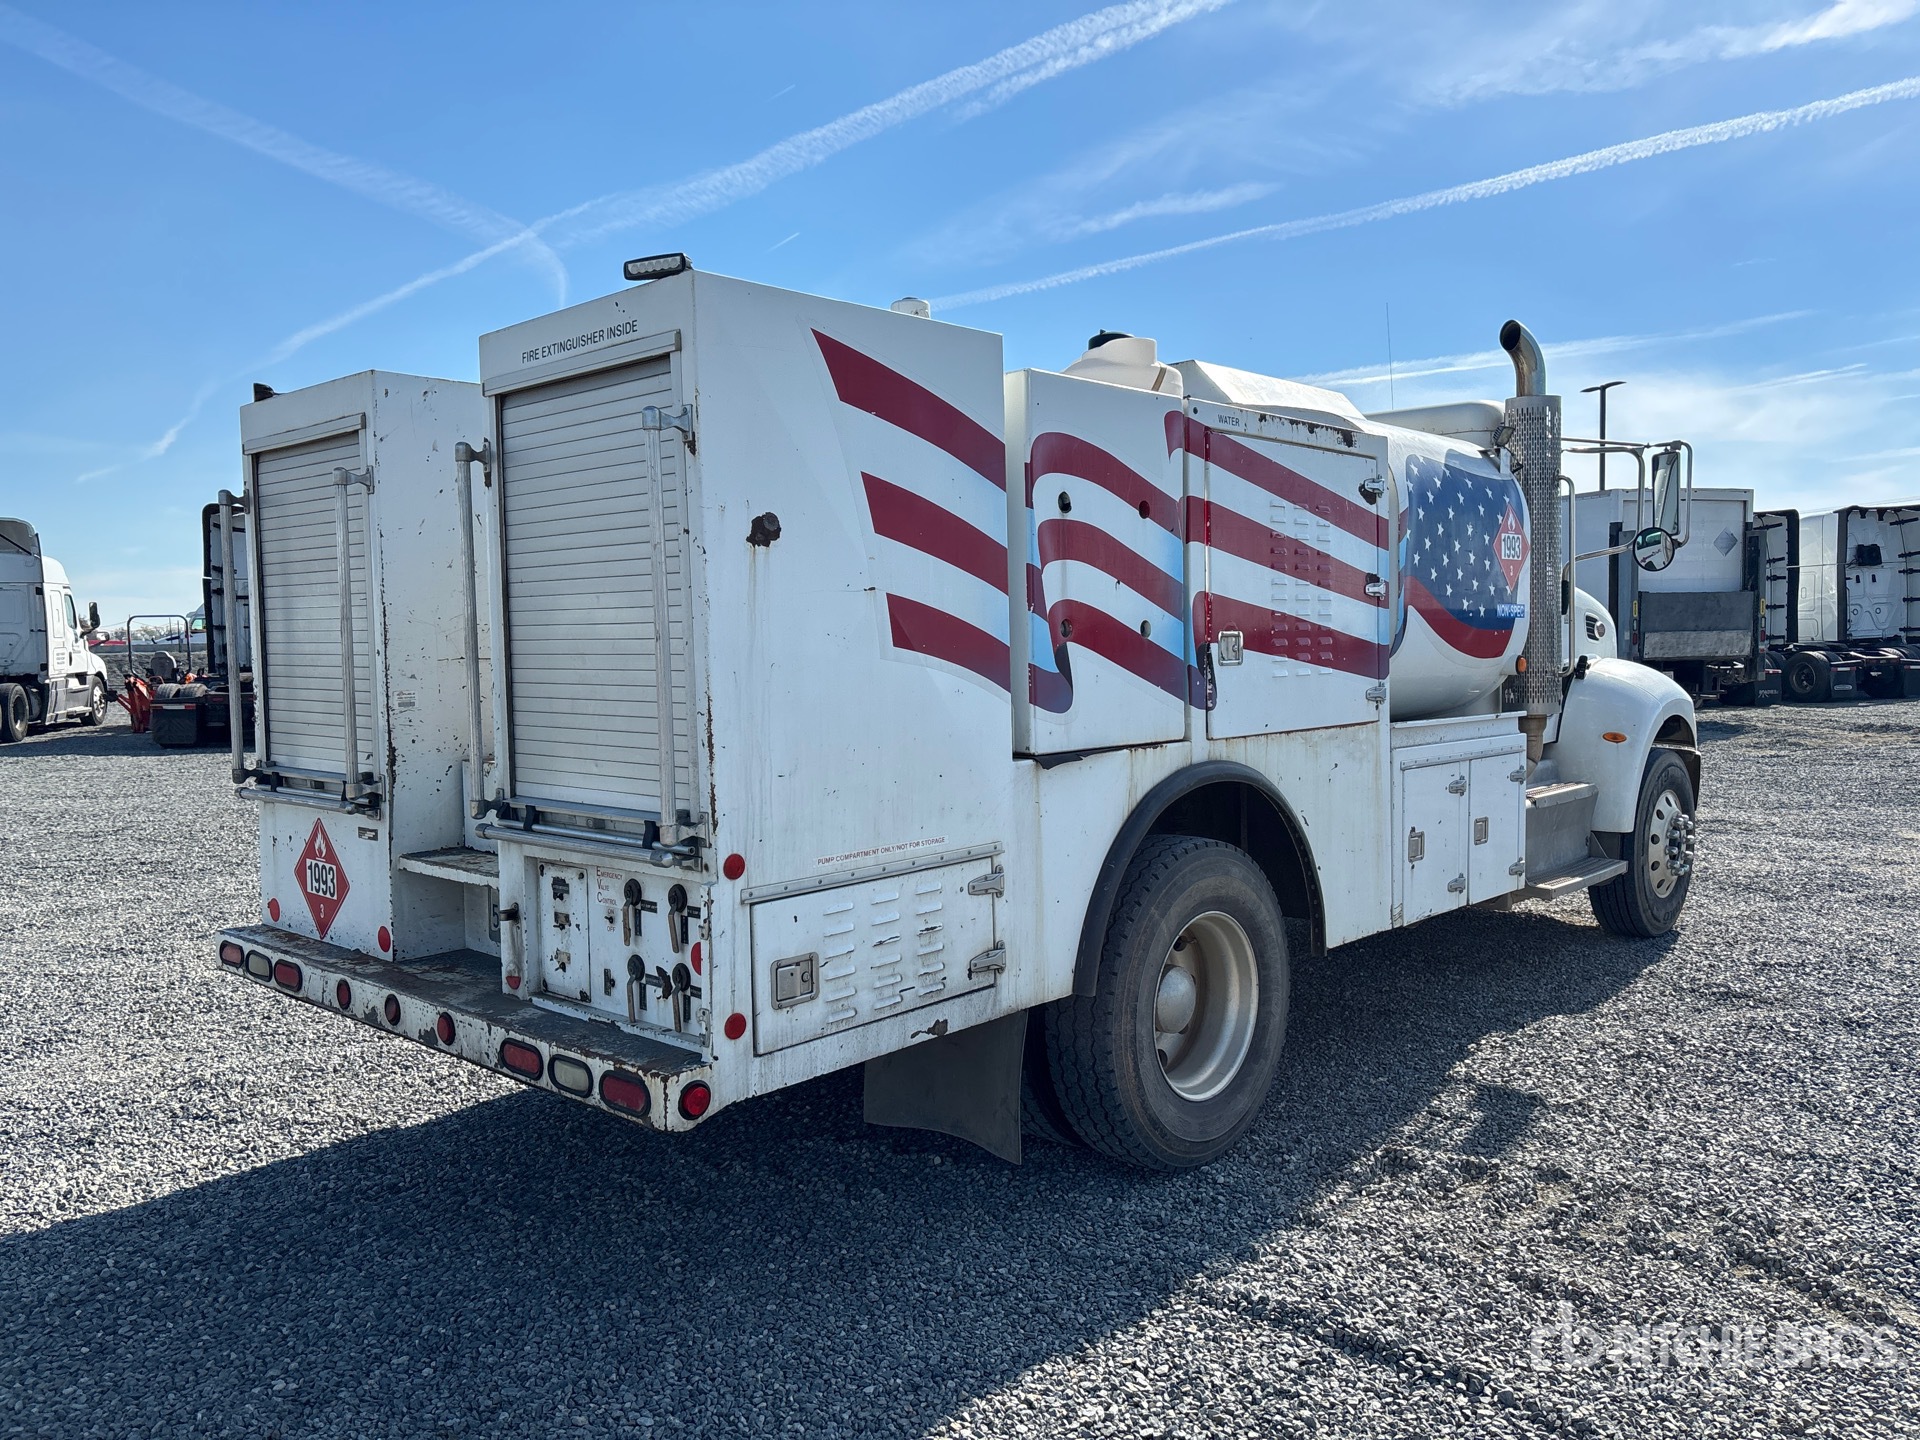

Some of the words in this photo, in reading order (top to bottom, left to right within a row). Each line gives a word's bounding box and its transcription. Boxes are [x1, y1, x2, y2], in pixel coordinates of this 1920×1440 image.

[522, 348, 540, 363] FIRE
[541, 329, 605, 359] EXTINGUISHER
[606, 320, 638, 340] INSIDE
[1217, 414, 1240, 427] WATER
[1502, 535, 1521, 559] 1993
[1497, 604, 1524, 617] NON-SPEC
[817, 856, 835, 866] PUMP
[835, 848, 880, 863] COMPARTMENT
[909, 841, 921, 849] FOR
[921, 837, 946, 847] STORAGE
[308, 861, 335, 897] 1993
[320, 904, 325, 918] 3
